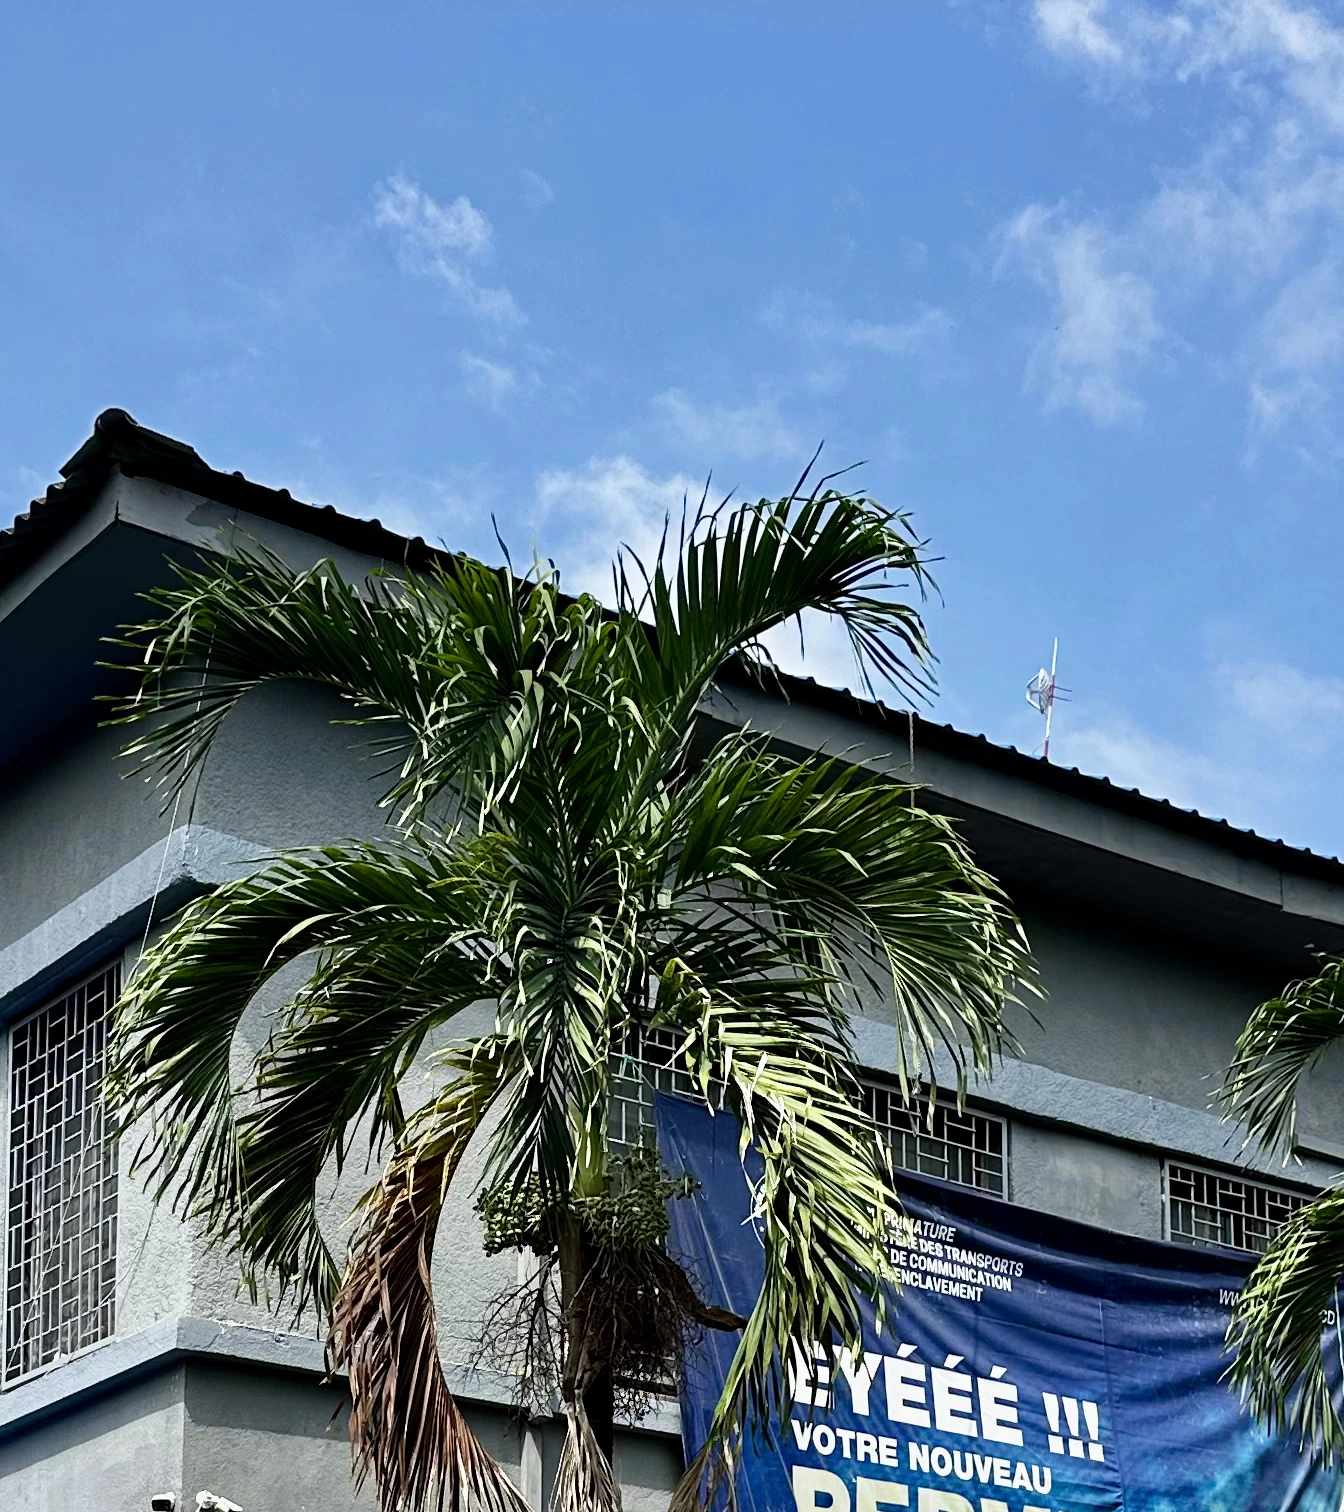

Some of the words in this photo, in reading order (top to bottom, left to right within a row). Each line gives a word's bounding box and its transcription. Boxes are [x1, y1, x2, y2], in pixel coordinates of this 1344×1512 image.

[890, 1248, 908, 1266] DE
[909, 1252, 1013, 1292] COMMUNICATION
[918, 1237, 944, 1258] DES
[944, 1245, 1024, 1278] TRANSPORTS
[1042, 1391, 1105, 1462] !!!
[790, 1418, 899, 1468] VOTRE
[908, 1441, 1053, 1495] NOUVEAU
